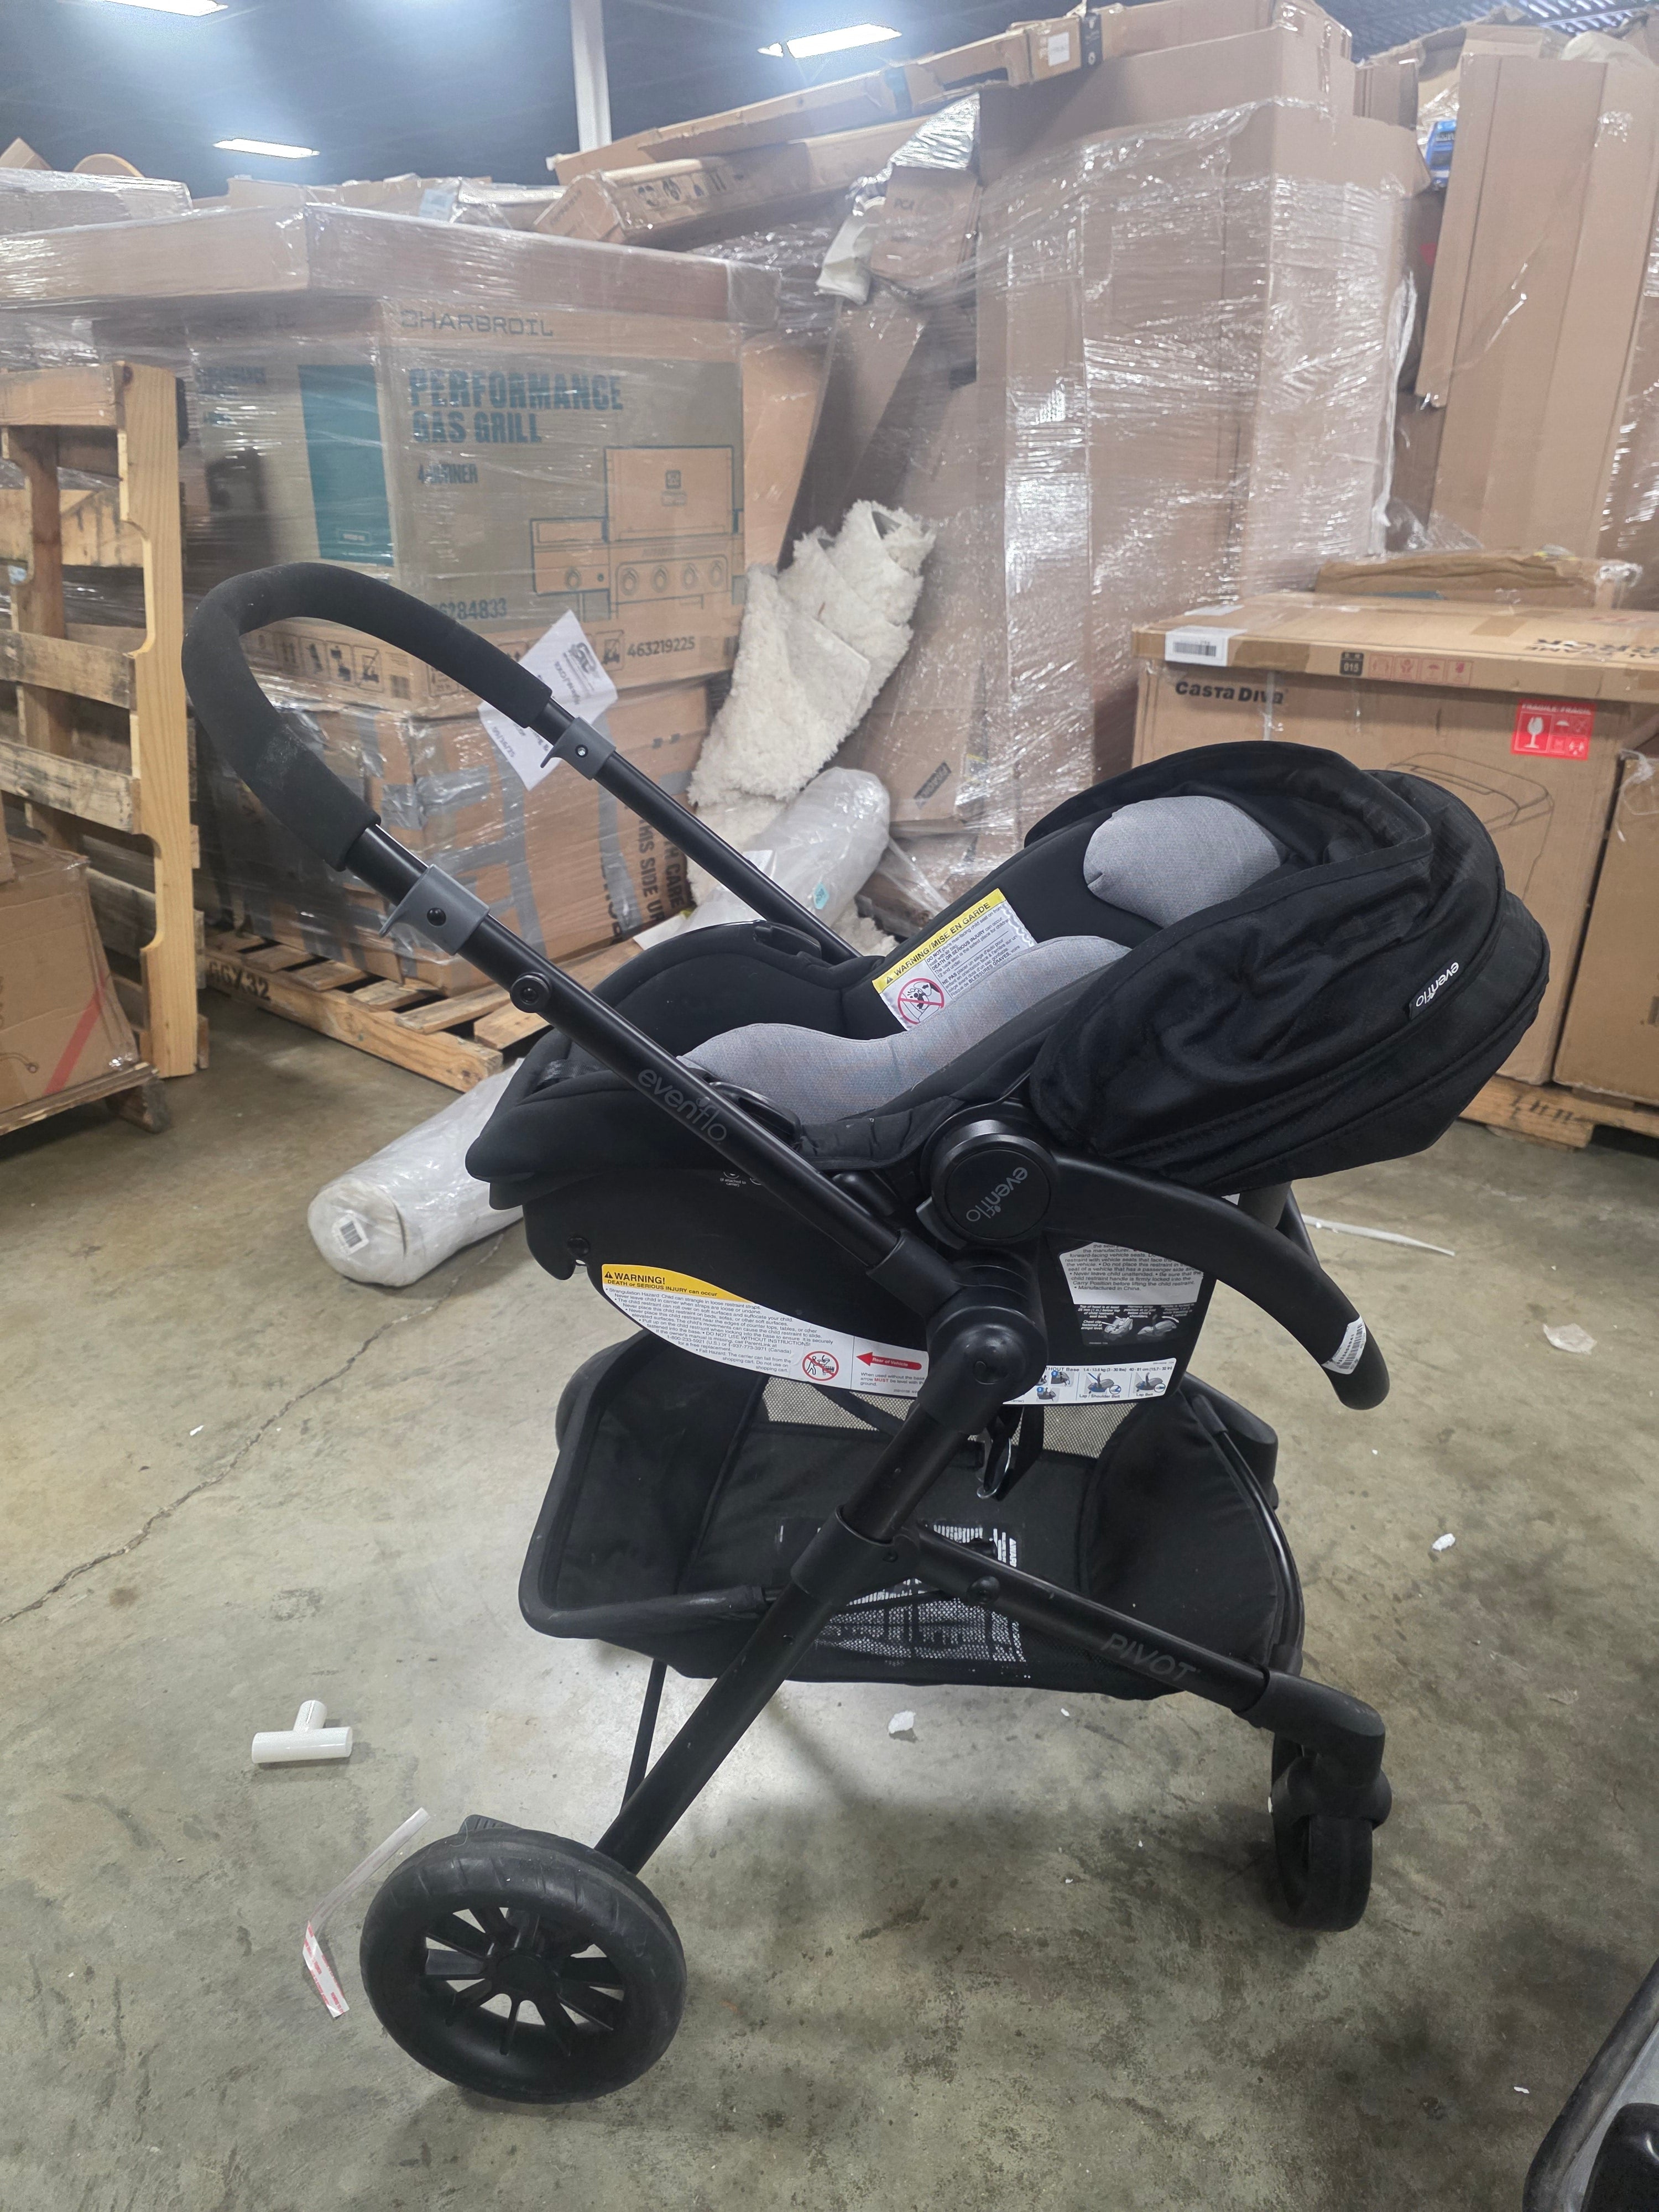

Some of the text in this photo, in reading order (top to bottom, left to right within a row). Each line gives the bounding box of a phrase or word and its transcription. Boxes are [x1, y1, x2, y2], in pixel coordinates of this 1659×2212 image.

[400, 310, 553, 337] CHARBROIL
[409, 368, 623, 410] PERFORMANCE
[413, 410, 541, 442] GAS GRILL
[627, 635, 696, 658] 463219225
[638, 857, 659, 898] SIDE
[664, 863, 686, 908] CARE
[932, 949, 942, 958] NOT
[941, 942, 952, 952] place
[951, 927, 972, 945] rear-facing
[969, 921, 980, 930] child
[978, 915, 989, 924] seat
[949, 922, 962, 934] EN
[961, 901, 991, 925] GARDE
[928, 958, 938, 967] seat
[936, 952, 945, 961] with
[931, 958, 946, 971] DEATH
[951, 940, 971, 956] SERIOUS
[969, 928, 985, 942] INJURY
[941, 960, 951, 969] back
[950, 954, 959, 963] seat
[968, 938, 981, 949] safest
[979, 931, 991, 941] place
[948, 972, 957, 980] PAS
[956, 963, 969, 974] placer
[994, 938, 1005, 947] pour
[941, 967, 951, 975] and
[967, 964, 994, 984] BLESSURES
[1415, 962, 1460, 1008] evenflo
[639, 1068, 727, 1144] evenflo
[966, 1167, 1029, 1222] evenflo
[608, 1287, 640, 1296] Strangulation
[613, 1271, 665, 1285] WARNING!
[1102, 1634, 1197, 1683] PIVOT
